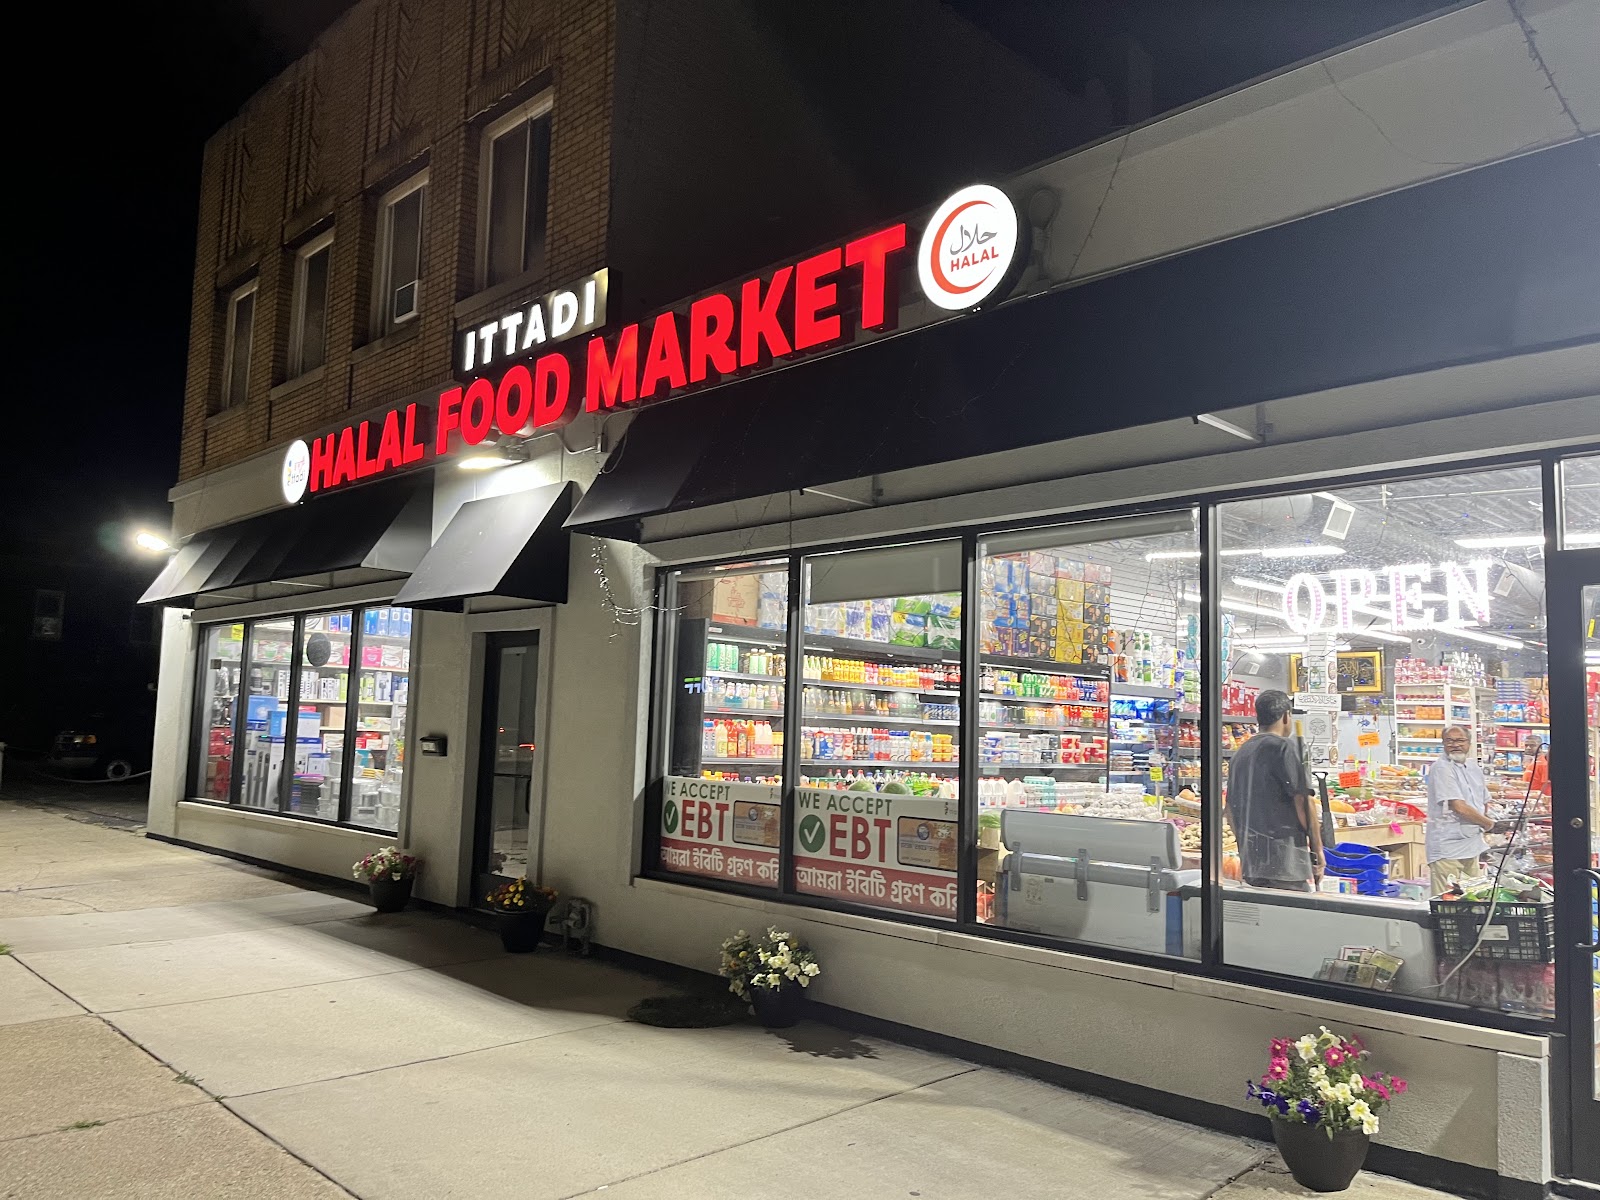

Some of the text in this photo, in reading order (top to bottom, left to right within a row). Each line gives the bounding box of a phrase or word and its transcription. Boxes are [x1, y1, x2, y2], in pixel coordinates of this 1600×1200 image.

[950, 223, 998, 256] حلال
[950, 246, 999, 273] HALAL
[464, 280, 596, 372] ITTADI
[310, 223, 906, 492] HALAL FOOD MARKET
[1282, 558, 1495, 634] OPEN
[663, 781, 731, 801] WE ACCEPT
[799, 791, 820, 809] WE
[826, 795, 893, 816] ACCEPT
[681, 799, 730, 842] EBT
[829, 813, 892, 863] EBT
[661, 846, 691, 867] আমরা
[692, 847, 725, 872] ইবিটি
[727, 856, 754, 877] গ্রহণ
[796, 866, 842, 891] আমরা
[845, 868, 887, 898] ইবিটি
[890, 879, 925, 905] গ্রহণ
